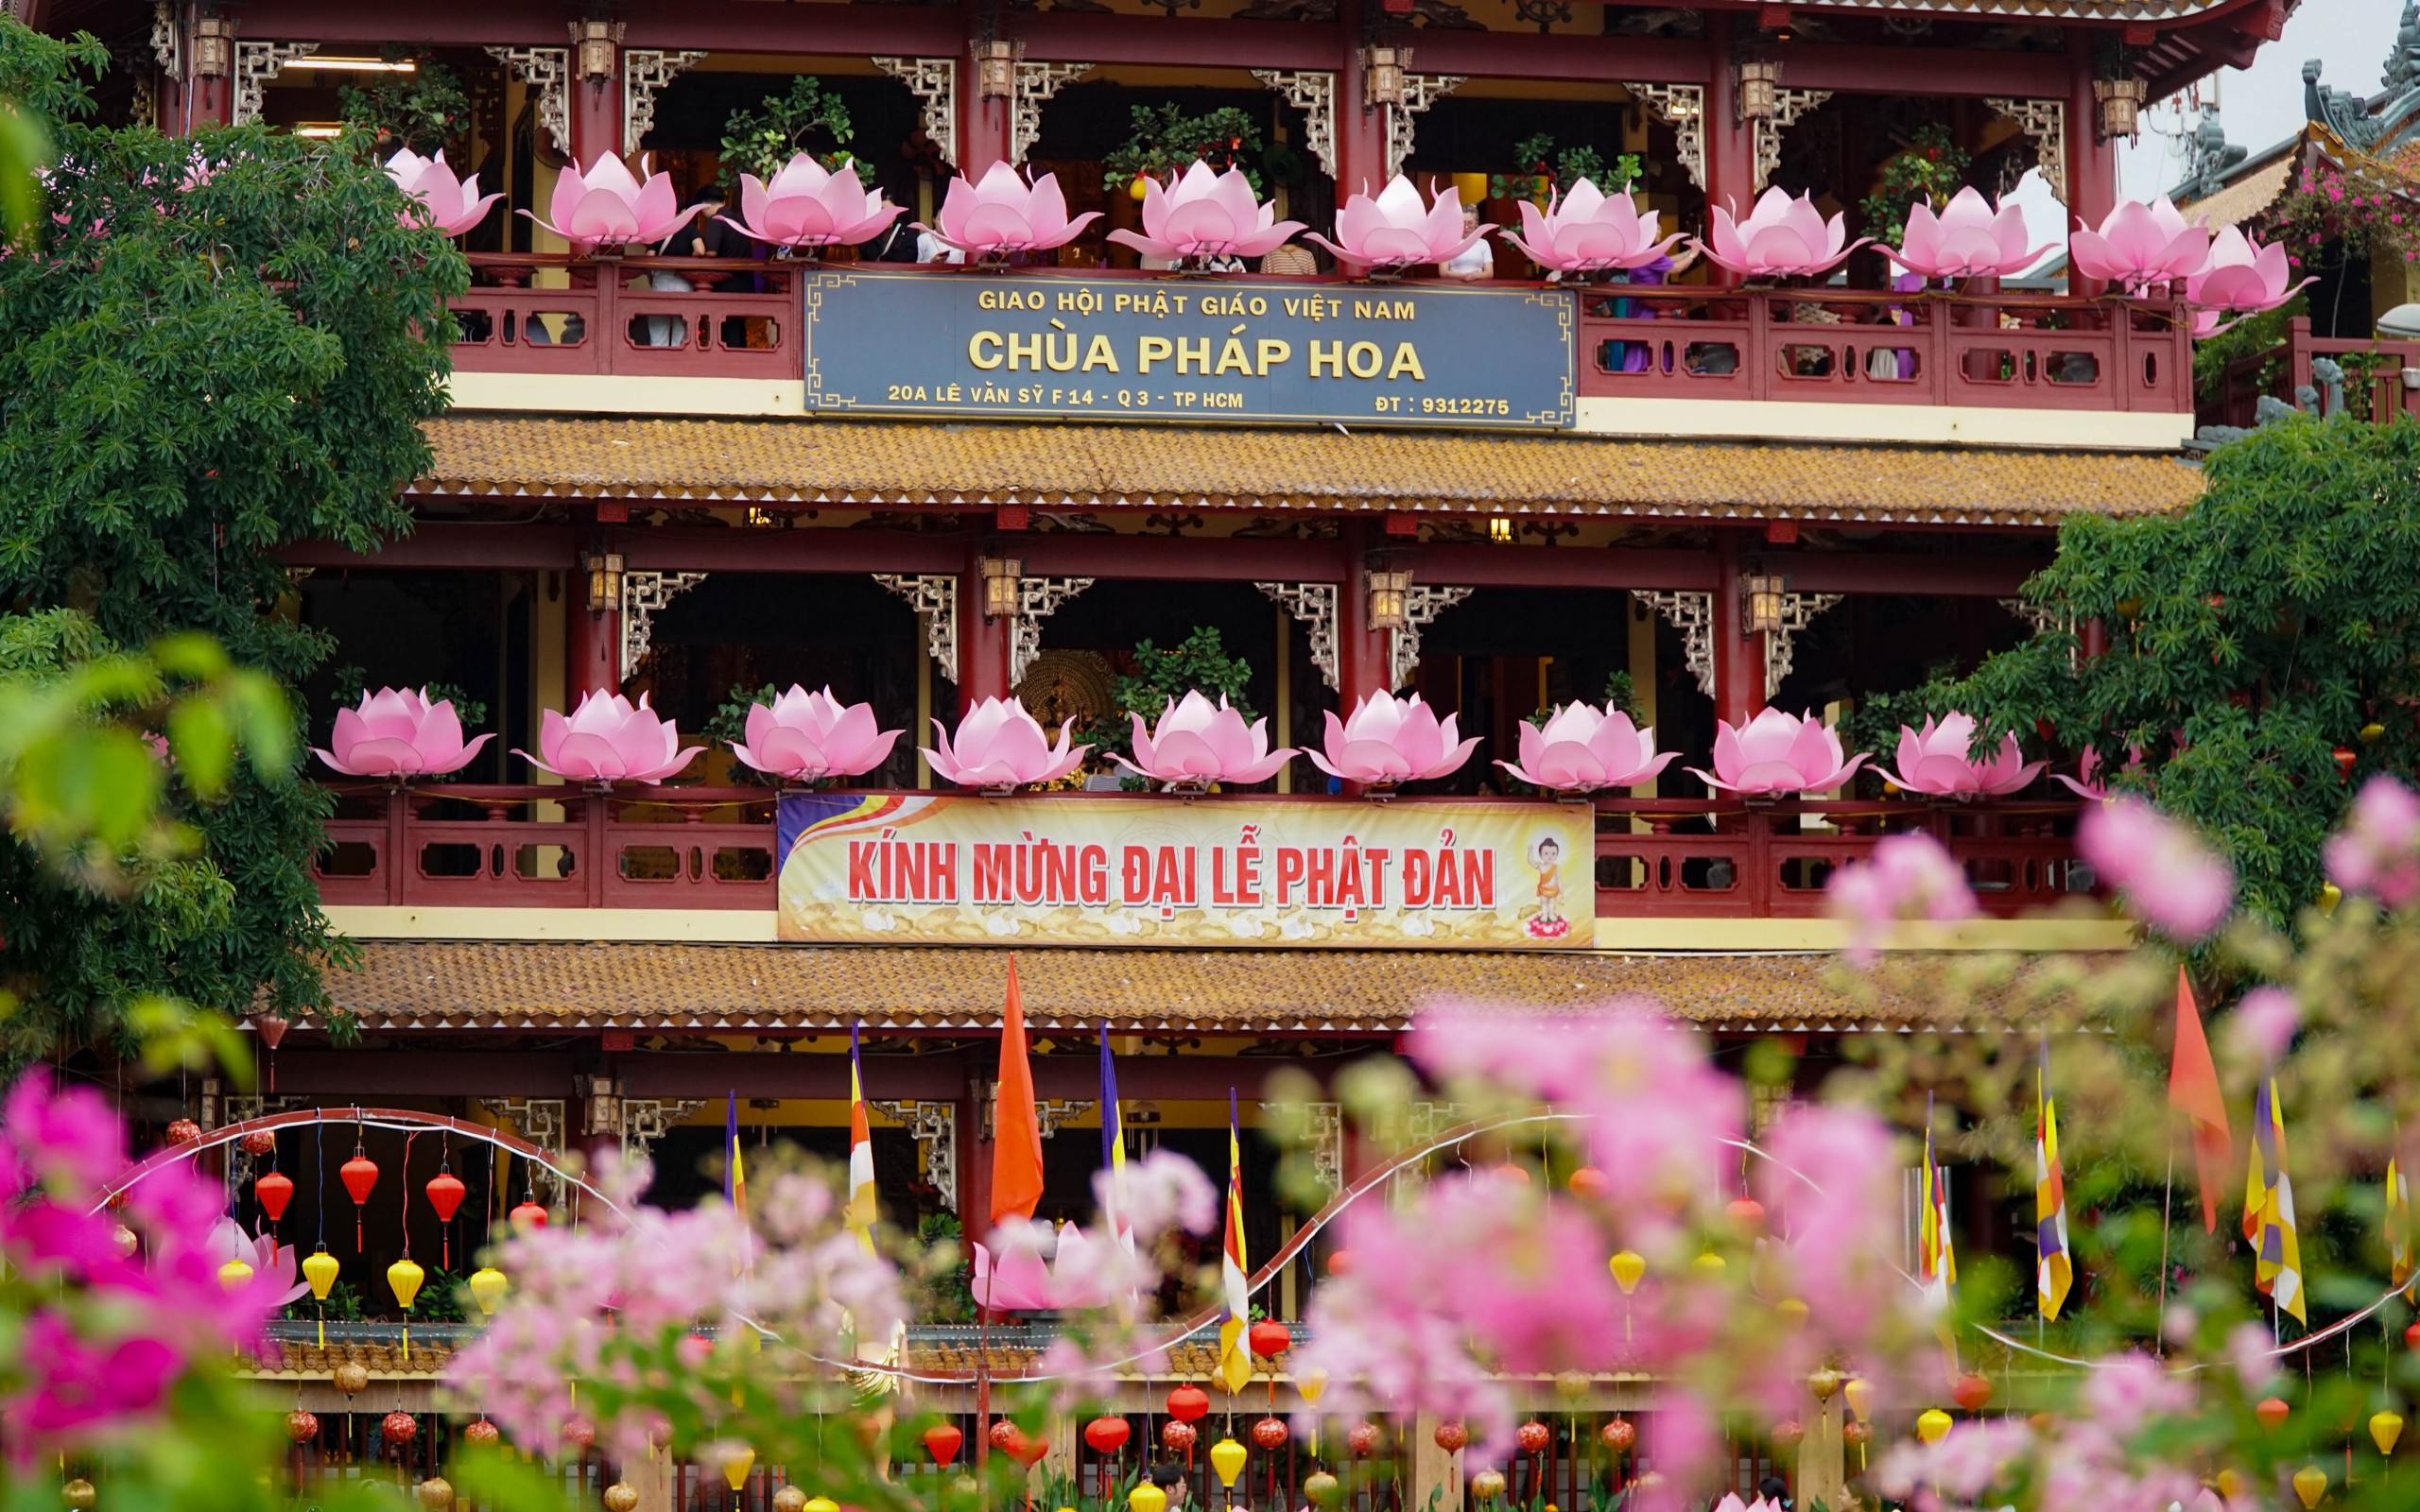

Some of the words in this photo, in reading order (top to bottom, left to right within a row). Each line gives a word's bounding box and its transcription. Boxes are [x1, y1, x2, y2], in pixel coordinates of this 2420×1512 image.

[1058, 287, 1103, 317] HỘI
[1115, 289, 1189, 319] PHẬT
[1201, 290, 1268, 317] GIÁO
[1284, 292, 1343, 322] VIỆT
[1355, 300, 1415, 320] NAM
[969, 318, 1120, 373] CHÙA
[1139, 323, 1291, 377] PHÁP
[1310, 338, 1426, 381] HOA
[889, 385, 927, 402] 20A
[936, 383, 961, 403] LÊ
[970, 381, 1010, 404] VĂN
[1018, 384, 1045, 404] SỸ
[1052, 388, 1063, 405] F
[1068, 389, 1094, 405] 14
[1117, 389, 1132, 408] Q
[1137, 390, 1150, 406] 3
[1173, 391, 1198, 407] TP
[1203, 392, 1244, 409] HCM
[1422, 398, 1510, 416] 9312275
[848, 828, 957, 902] KÍNH
[972, 830, 1107, 903] MỪNG
[1121, 845, 1197, 918] ĐẠI
[1212, 824, 1261, 904] LỄ
[1277, 834, 1390, 920] PHẬT
[1402, 828, 1495, 906] ĐẢN
